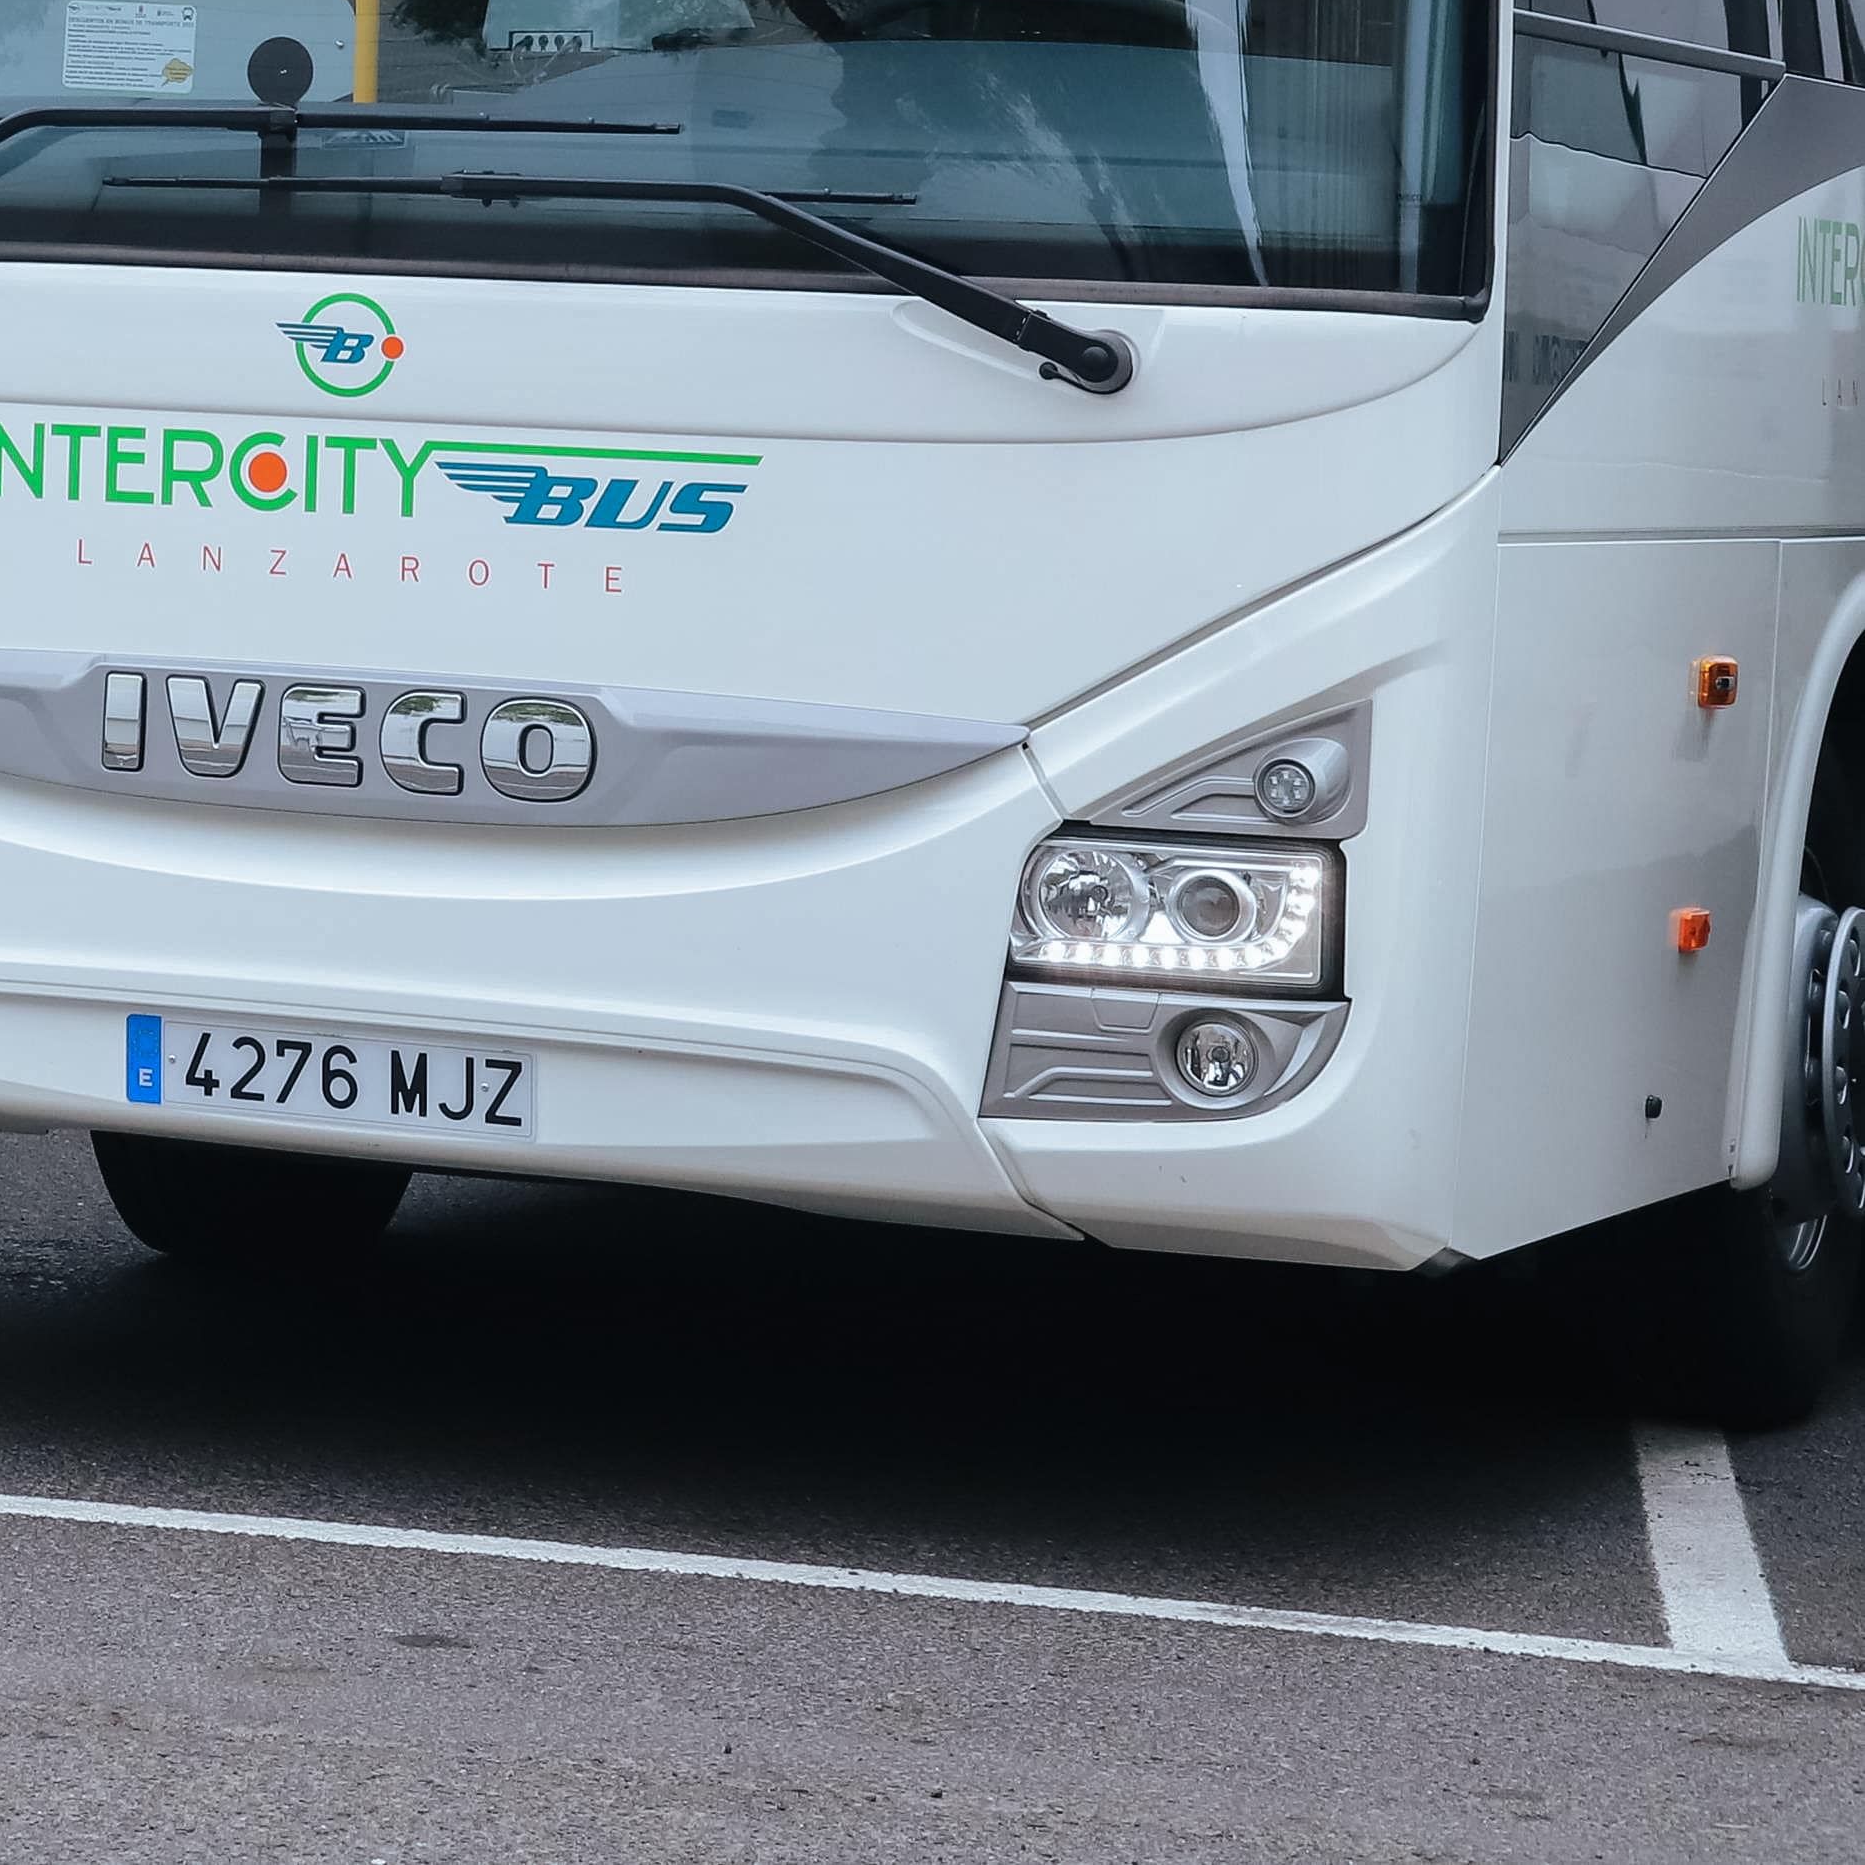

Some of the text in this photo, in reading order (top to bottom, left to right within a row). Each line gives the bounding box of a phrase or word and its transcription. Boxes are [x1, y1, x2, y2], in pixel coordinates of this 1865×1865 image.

[1796, 216, 1865, 306] INTER
[500, 467, 750, 534] BUS
[76, 536, 624, 594] LANZAROTE
[100, 670, 598, 803] IVECO
[138, 1032, 523, 1127] E 4276 MJZ
